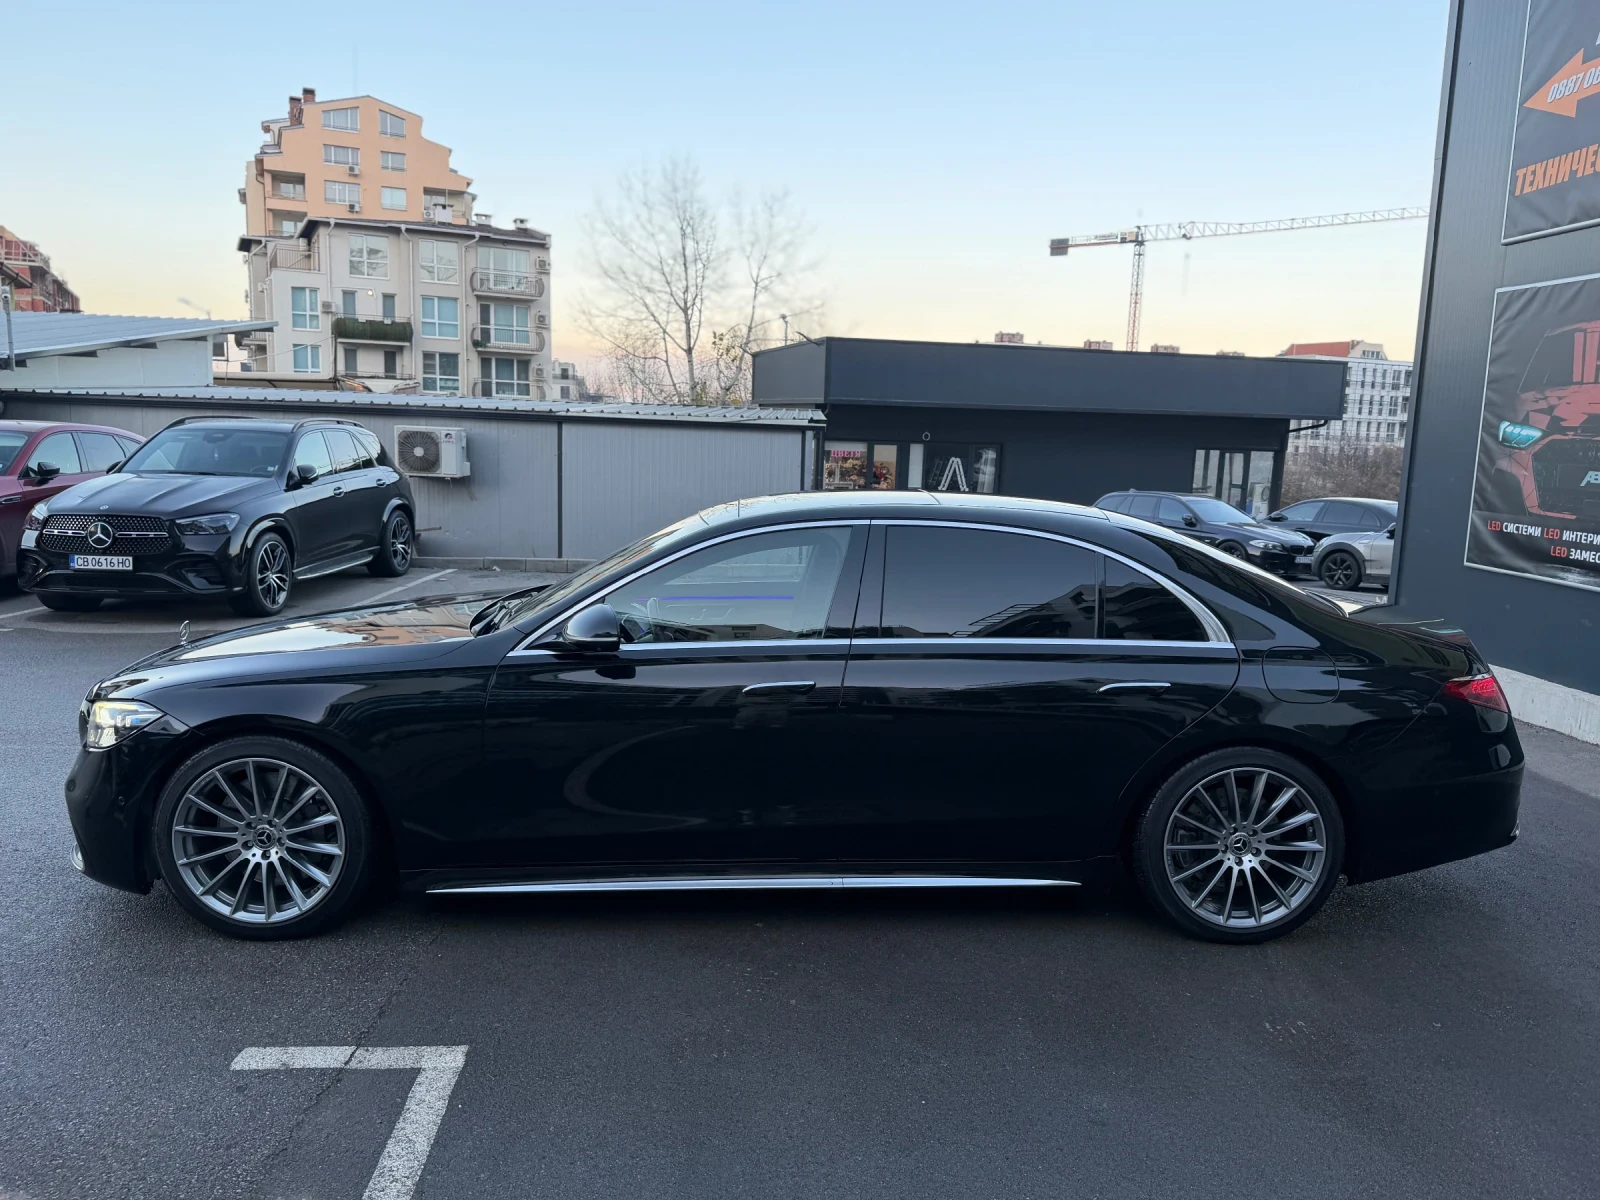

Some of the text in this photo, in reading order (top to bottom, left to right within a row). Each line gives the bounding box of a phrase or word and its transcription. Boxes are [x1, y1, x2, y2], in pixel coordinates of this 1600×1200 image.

[1547, 71, 1585, 103] 0887
[1487, 520, 1600, 546] LED СИСТЕМИ LED ИНТЕРИ
[1550, 545, 1568, 558] LED
[76, 556, 89, 567] CB
[91, 557, 115, 568] 0616
